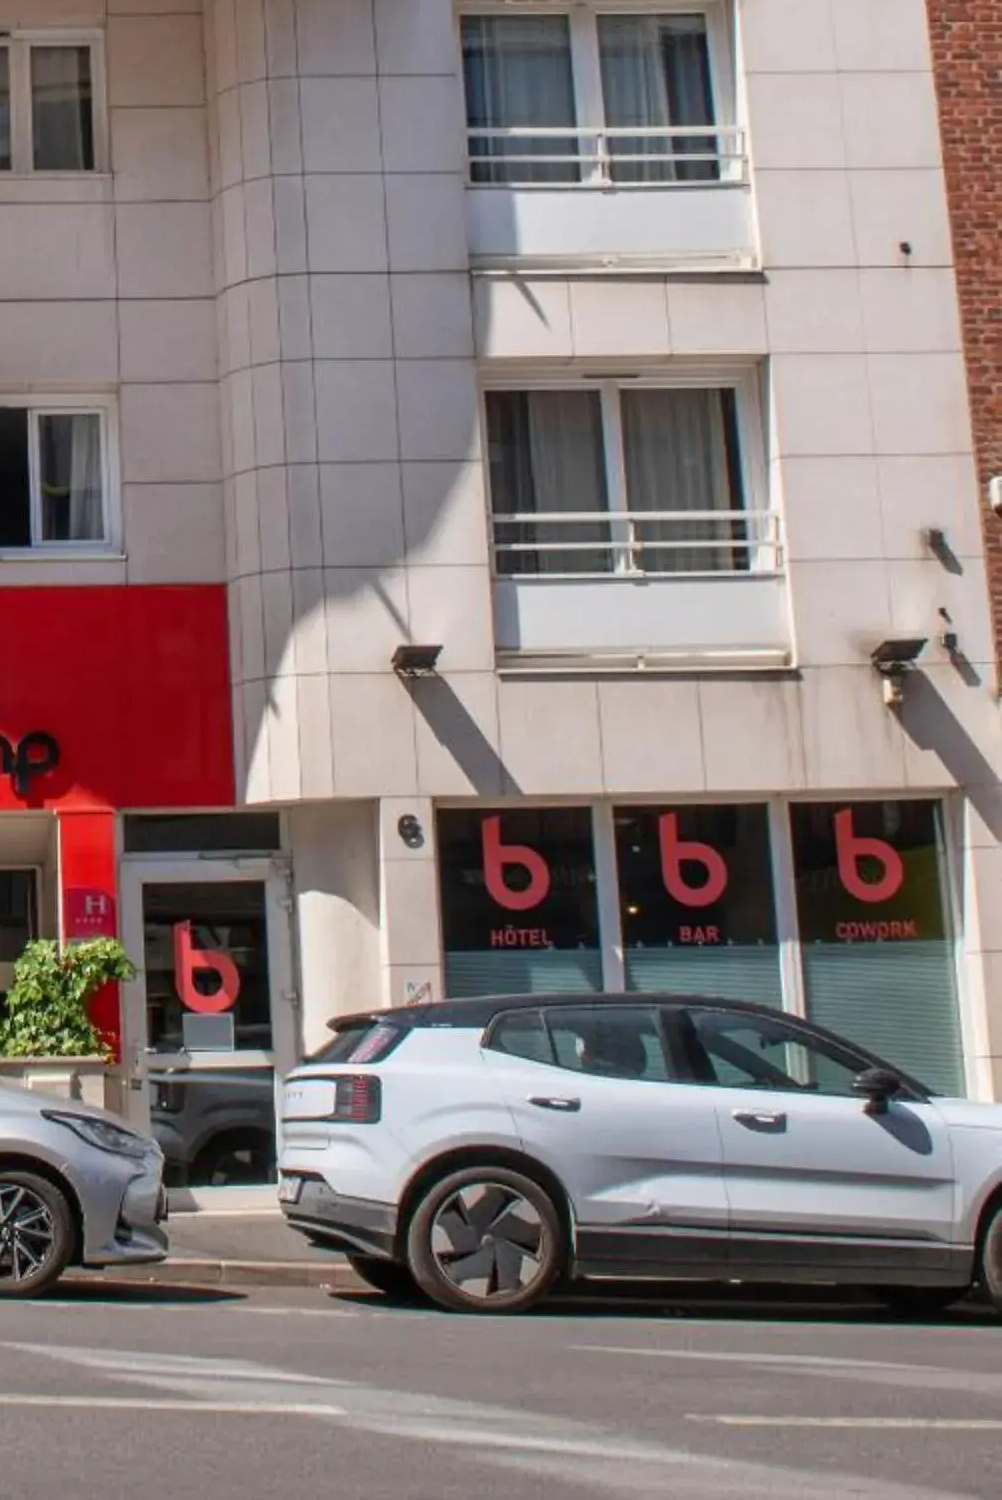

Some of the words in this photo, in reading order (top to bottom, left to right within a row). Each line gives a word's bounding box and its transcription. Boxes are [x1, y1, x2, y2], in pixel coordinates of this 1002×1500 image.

[482, 816, 550, 910] b
[659, 812, 728, 907] b
[835, 807, 903, 902] b
[85, 895, 106, 915] H
[679, 925, 720, 943] BAR
[836, 921, 917, 939] COWORK
[491, 925, 553, 947] HÔTEL
[173, 919, 241, 1013] b
